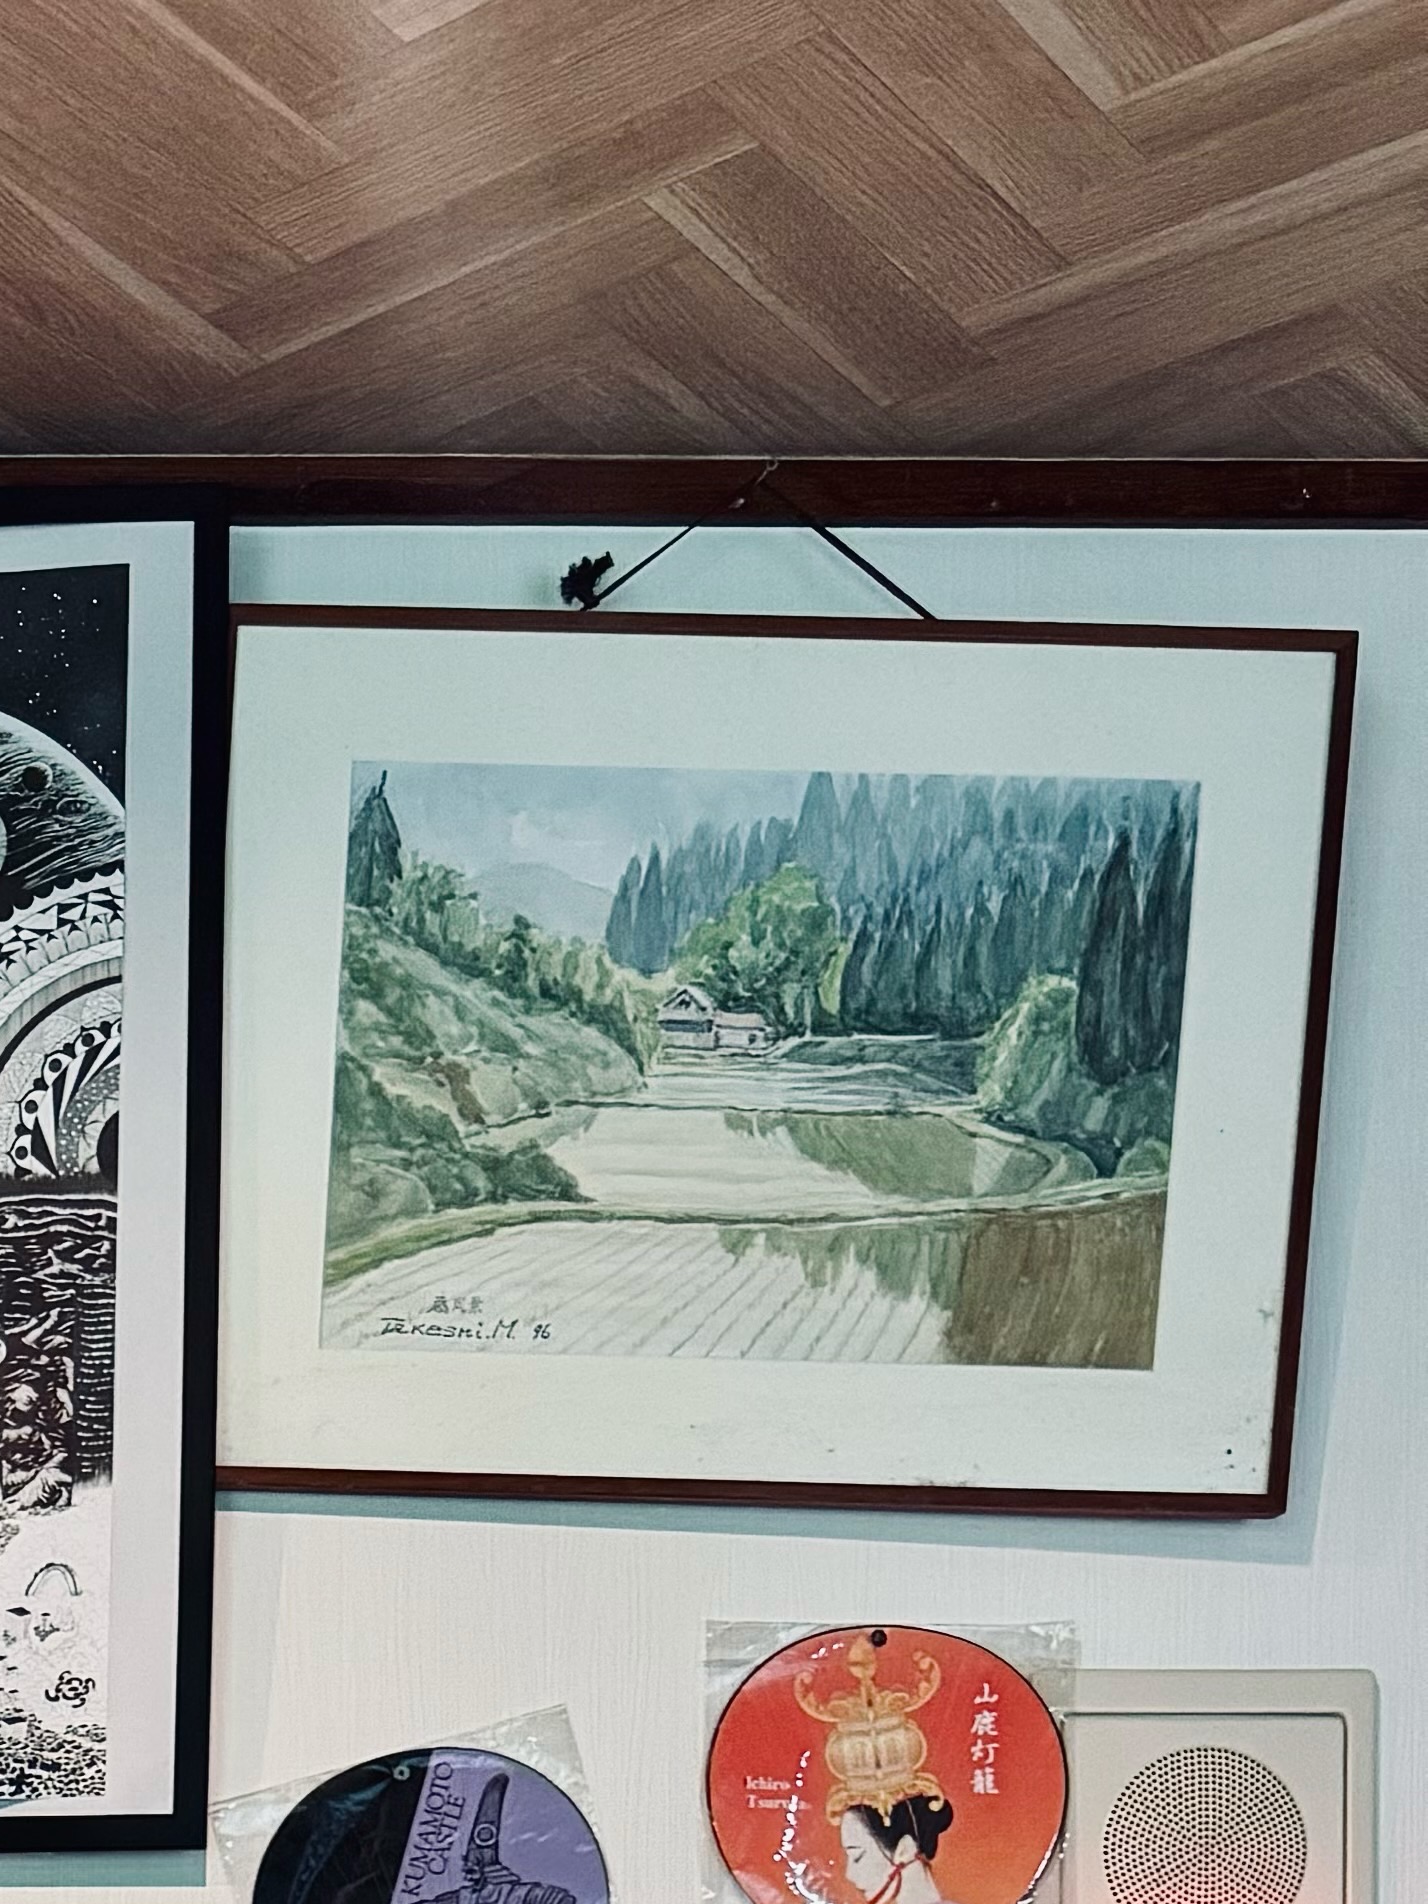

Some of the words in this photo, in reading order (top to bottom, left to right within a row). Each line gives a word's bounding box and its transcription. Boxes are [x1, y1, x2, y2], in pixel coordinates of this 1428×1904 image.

[746, 1775, 791, 1790] Ichiro
[400, 1761, 454, 1897] KUMAMOTO
[428, 1794, 466, 1875] CASTLE
